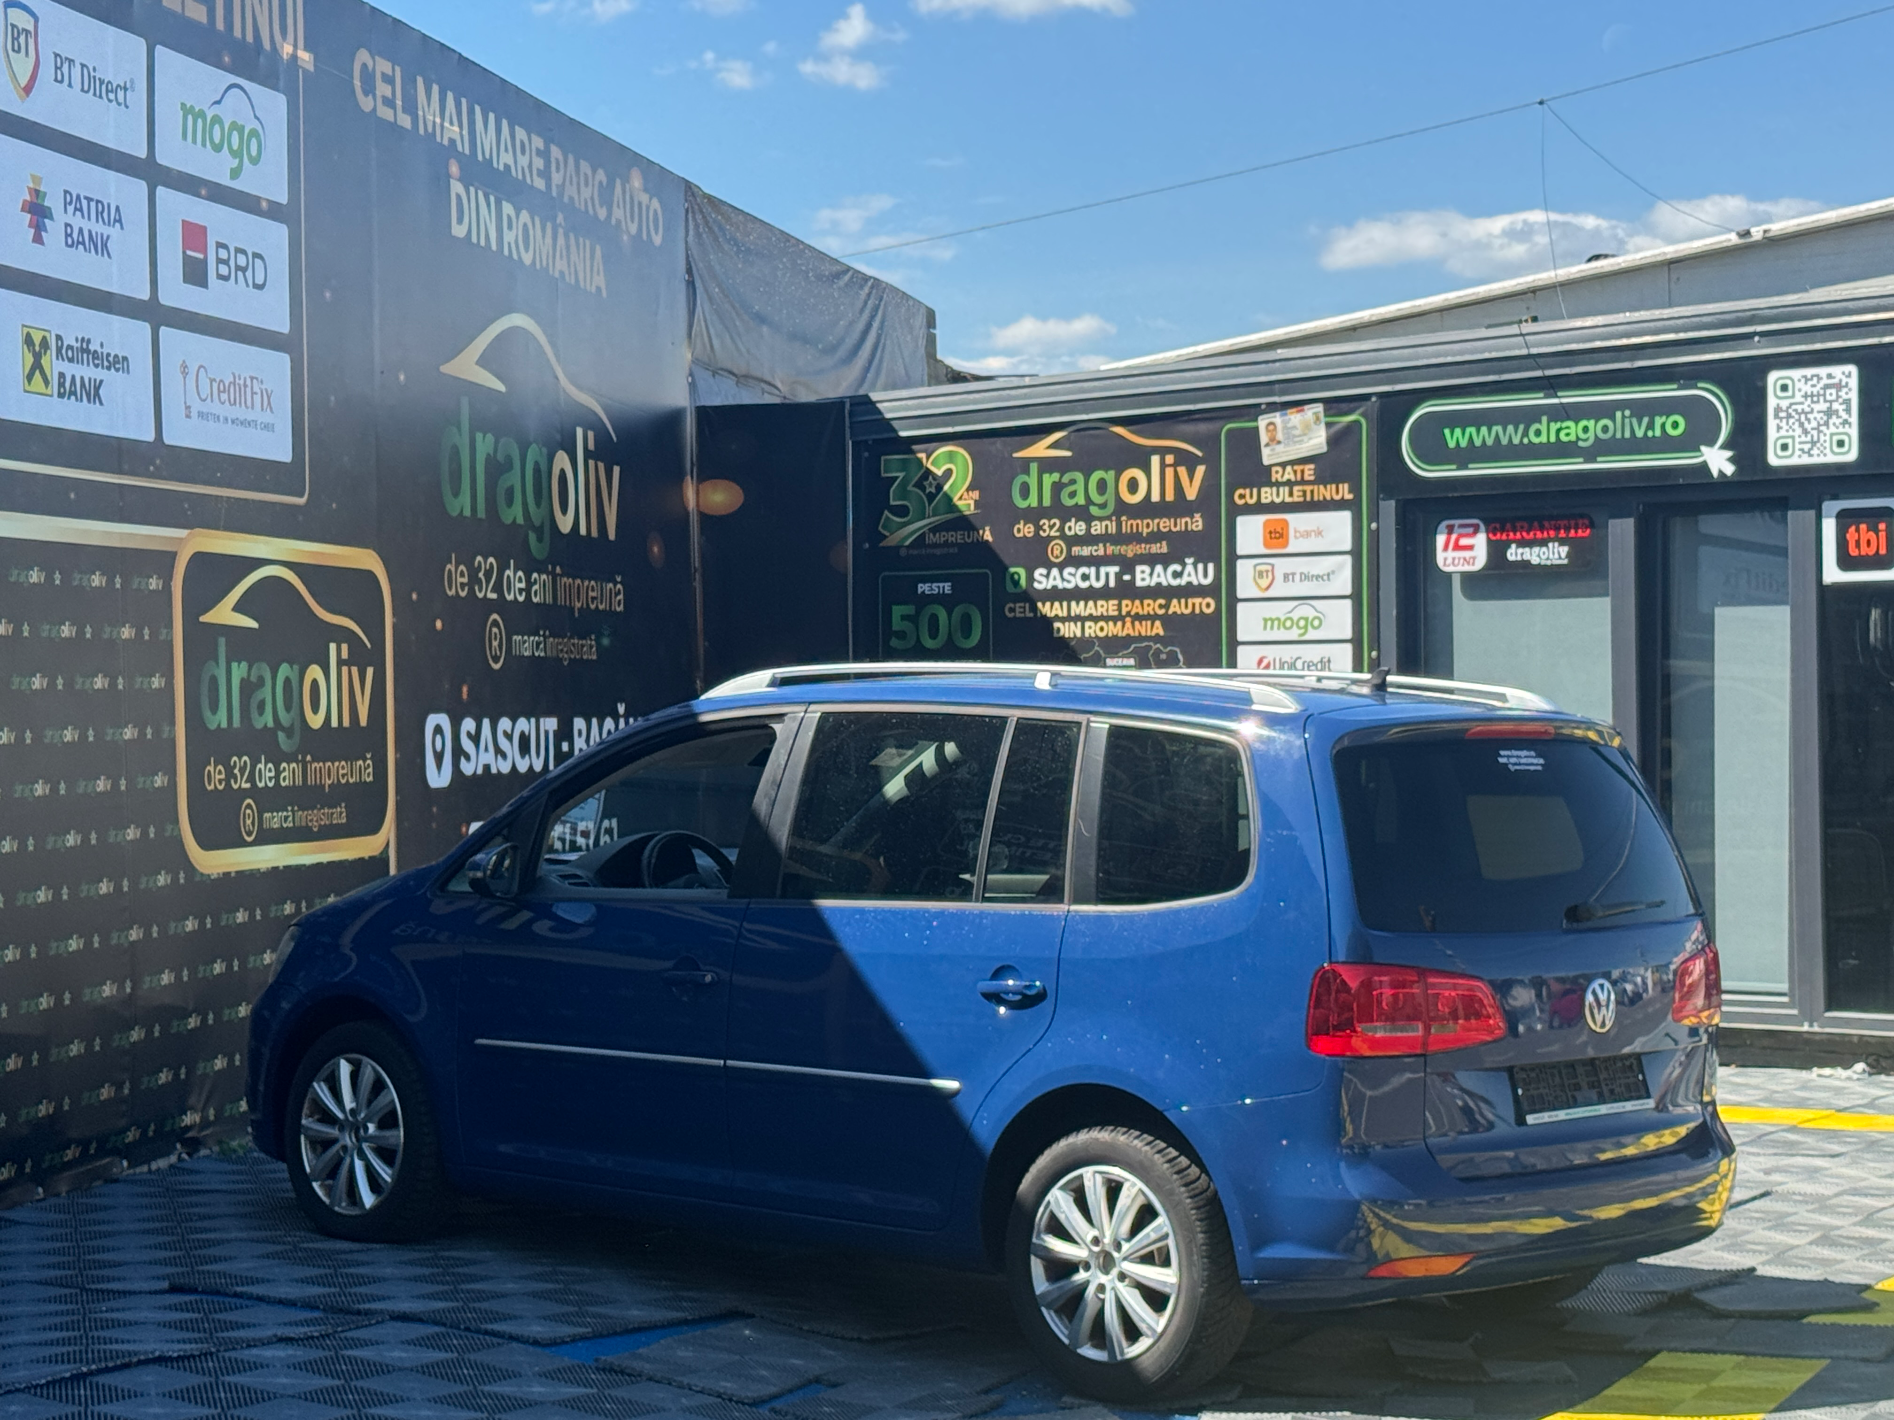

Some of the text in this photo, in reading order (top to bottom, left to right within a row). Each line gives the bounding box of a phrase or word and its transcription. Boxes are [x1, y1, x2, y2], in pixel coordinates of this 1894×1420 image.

[9, 22, 32, 58] BT
[52, 51, 76, 88] BT
[180, 101, 264, 181] mogo
[353, 48, 664, 247] CEL MAI MARE PARC AUTO
[63, 189, 125, 231] PATRIA
[64, 223, 113, 259] BANK
[450, 178, 607, 298] DIN ROMÂNIA
[215, 241, 268, 292] BRD
[55, 333, 130, 375] Raiffeisen
[57, 371, 105, 406] BANK
[195, 364, 274, 414] CreditFix
[1443, 410, 1686, 449] www.dragoliv.ro
[440, 396, 621, 561] dragoliv
[1011, 454, 1206, 517] dragoliv
[1271, 464, 1315, 482] RATE
[878, 445, 980, 537] 32 ANI
[1234, 482, 1354, 505] CU BULETINUL
[925, 525, 994, 545] ÎMPREUNĂ
[1013, 513, 1204, 538] de 32 de ani împreună
[1267, 526, 1325, 541] tbi bank
[1442, 518, 1592, 553] 12 GARANTIE
[1846, 521, 1888, 557] tbi
[1071, 543, 1104, 556] marcă
[1106, 540, 1168, 558] înregistrată
[1443, 555, 1477, 568] LUNI
[1506, 542, 1569, 564] dragoliv
[8, 567, 164, 592] dragoliv dragoliv dragoliv
[444, 553, 625, 617] de 32 de ani împreună
[917, 582, 952, 595] PESTE
[1033, 566, 1120, 590] SASCUT
[1135, 557, 1215, 588] BACĂU
[1257, 569, 1271, 580] BT
[1283, 572, 1297, 583] BT
[1005, 597, 1216, 618] CEL MAI MARE PARC AUTO
[39, 621, 77, 641] dragoliv
[102, 623, 136, 643] dragoliv
[889, 603, 982, 650] 500
[1053, 617, 1165, 638] DIN ROMÂNIA
[1262, 615, 1323, 638] mogo
[512, 630, 545, 657] marcă
[1272, 656, 1332, 672] UniCredit
[10, 673, 166, 693] dragoliv dragoliv dragoliv
[202, 637, 374, 753] dragoliv
[44, 725, 80, 746] dragoliv
[105, 724, 139, 744] dragoliv
[459, 717, 558, 776] SASCUT
[13, 771, 169, 801] dragoliv dragoliv dragoliv
[204, 753, 374, 792] de 32 de ani împreună
[263, 806, 293, 830] marcă
[295, 802, 347, 831] înregistrată
